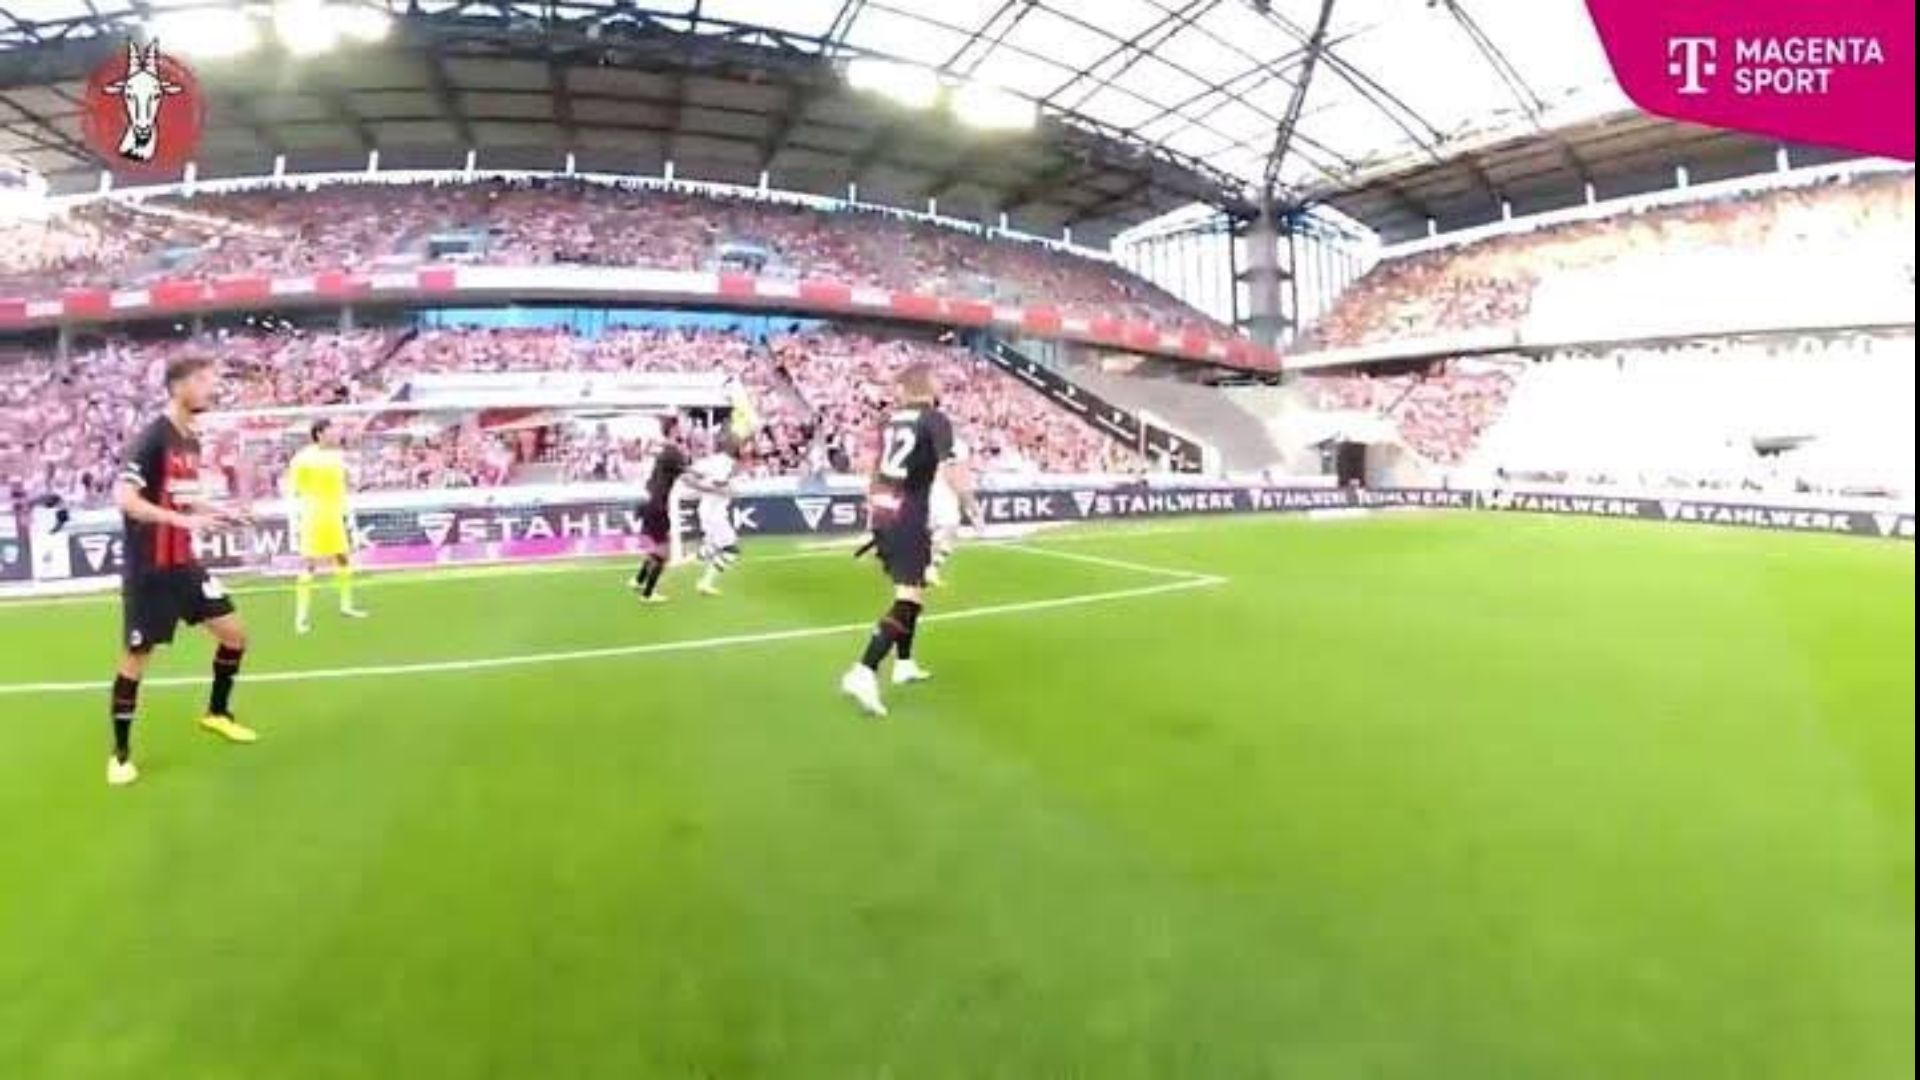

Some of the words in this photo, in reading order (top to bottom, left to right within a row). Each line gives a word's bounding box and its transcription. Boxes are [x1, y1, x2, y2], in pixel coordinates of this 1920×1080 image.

[881, 425, 916, 479] 12
[1096, 492, 1234, 513] STAHLWERK
[1681, 502, 1851, 530] STAHLWERK
